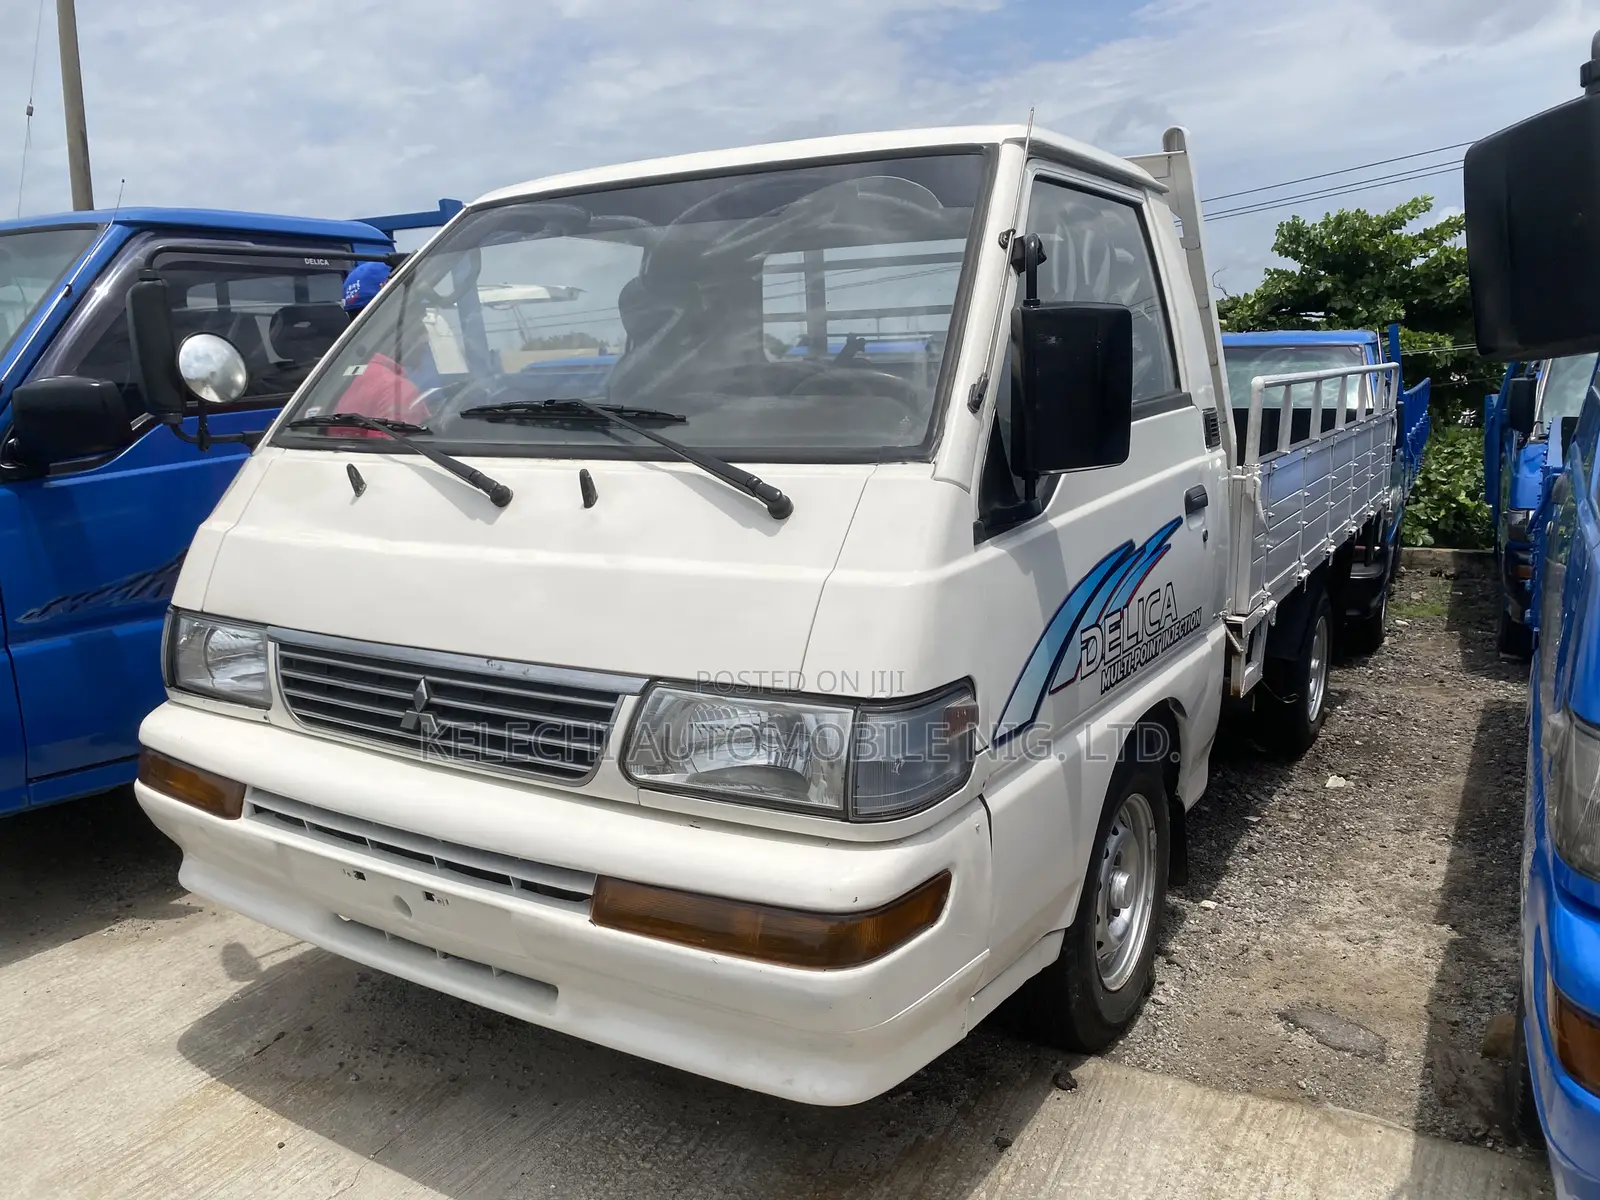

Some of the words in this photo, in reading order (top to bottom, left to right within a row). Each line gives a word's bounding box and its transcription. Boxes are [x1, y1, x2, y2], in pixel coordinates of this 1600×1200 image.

[304, 257, 330, 266] DELICA
[1080, 581, 1178, 681] DELICA
[1100, 635, 1163, 695] MULTI-POINT
[1161, 606, 1203, 650] INJECTION
